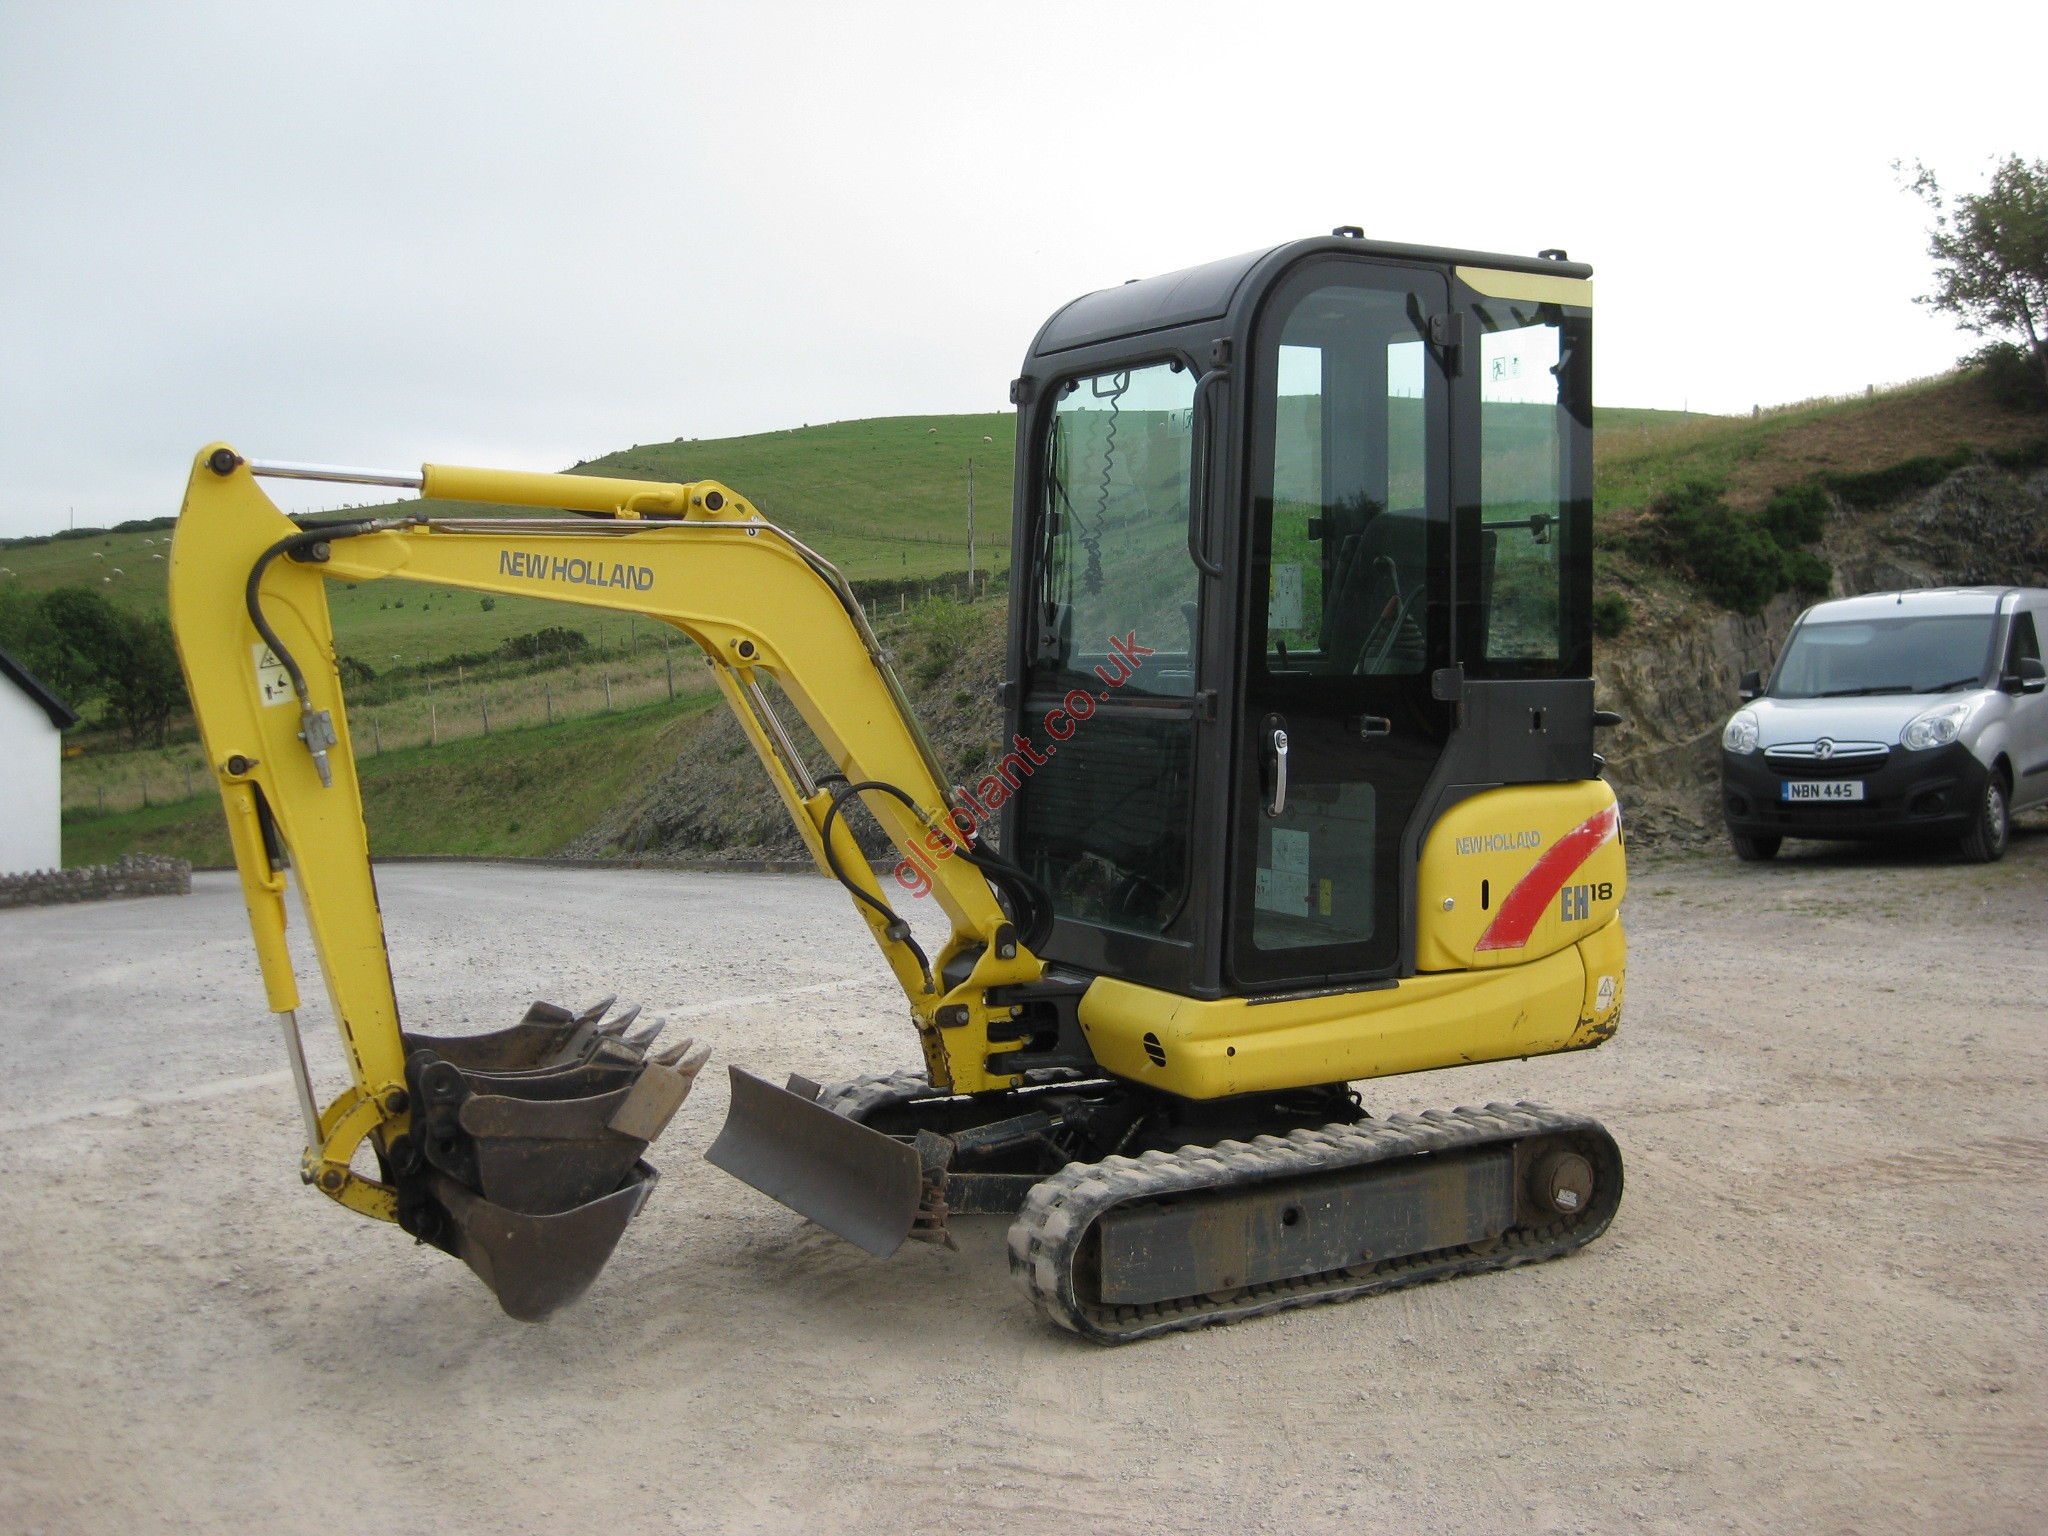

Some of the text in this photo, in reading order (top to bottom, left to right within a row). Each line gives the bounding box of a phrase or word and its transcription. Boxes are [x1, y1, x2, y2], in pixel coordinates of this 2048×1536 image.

[499, 550, 654, 591] NEW HOLLAND
[1791, 783, 1852, 798] NBN 445
[1456, 830, 1541, 855] NEW HOLLAND
